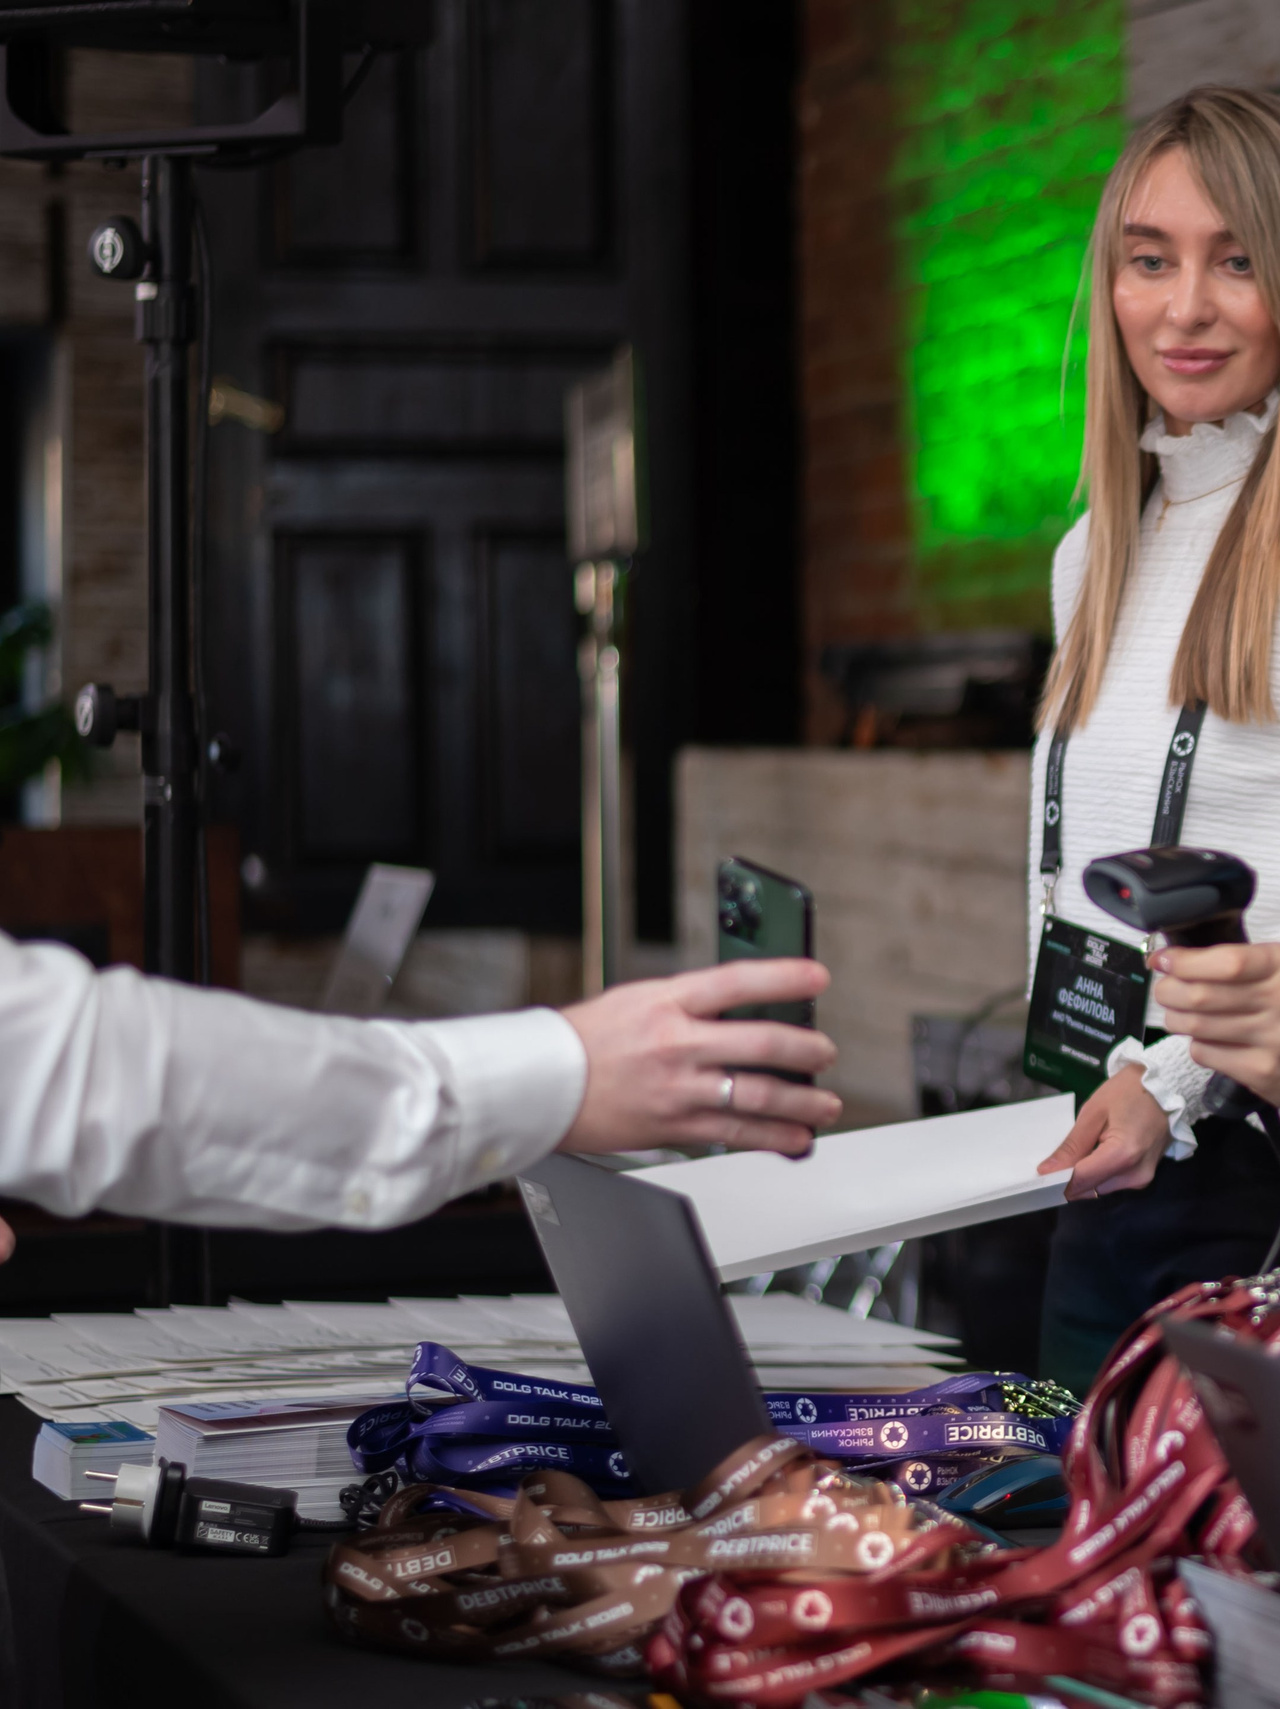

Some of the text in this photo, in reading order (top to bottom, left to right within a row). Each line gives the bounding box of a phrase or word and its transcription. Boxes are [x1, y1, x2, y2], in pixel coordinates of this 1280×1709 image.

[1075, 976, 1103, 1000] АННА
[1058, 988, 1115, 1025] ФЕФИЛОВА
[493, 1380, 532, 1394] DOLG
[533, 1386, 570, 1400] TALK
[507, 1414, 550, 1426] DOLG
[554, 1417, 591, 1428] TALK
[811, 1427, 874, 1438] ВЗЫСКАНИЯ
[838, 1438, 874, 1447] РЫНОК
[948, 1425, 1046, 1447] DEBTPRICE
[204, 1503, 228, 1511] Lenovo
[708, 1533, 814, 1557] DEBTPRICE
[457, 1576, 567, 1612] DEBTPRICE
